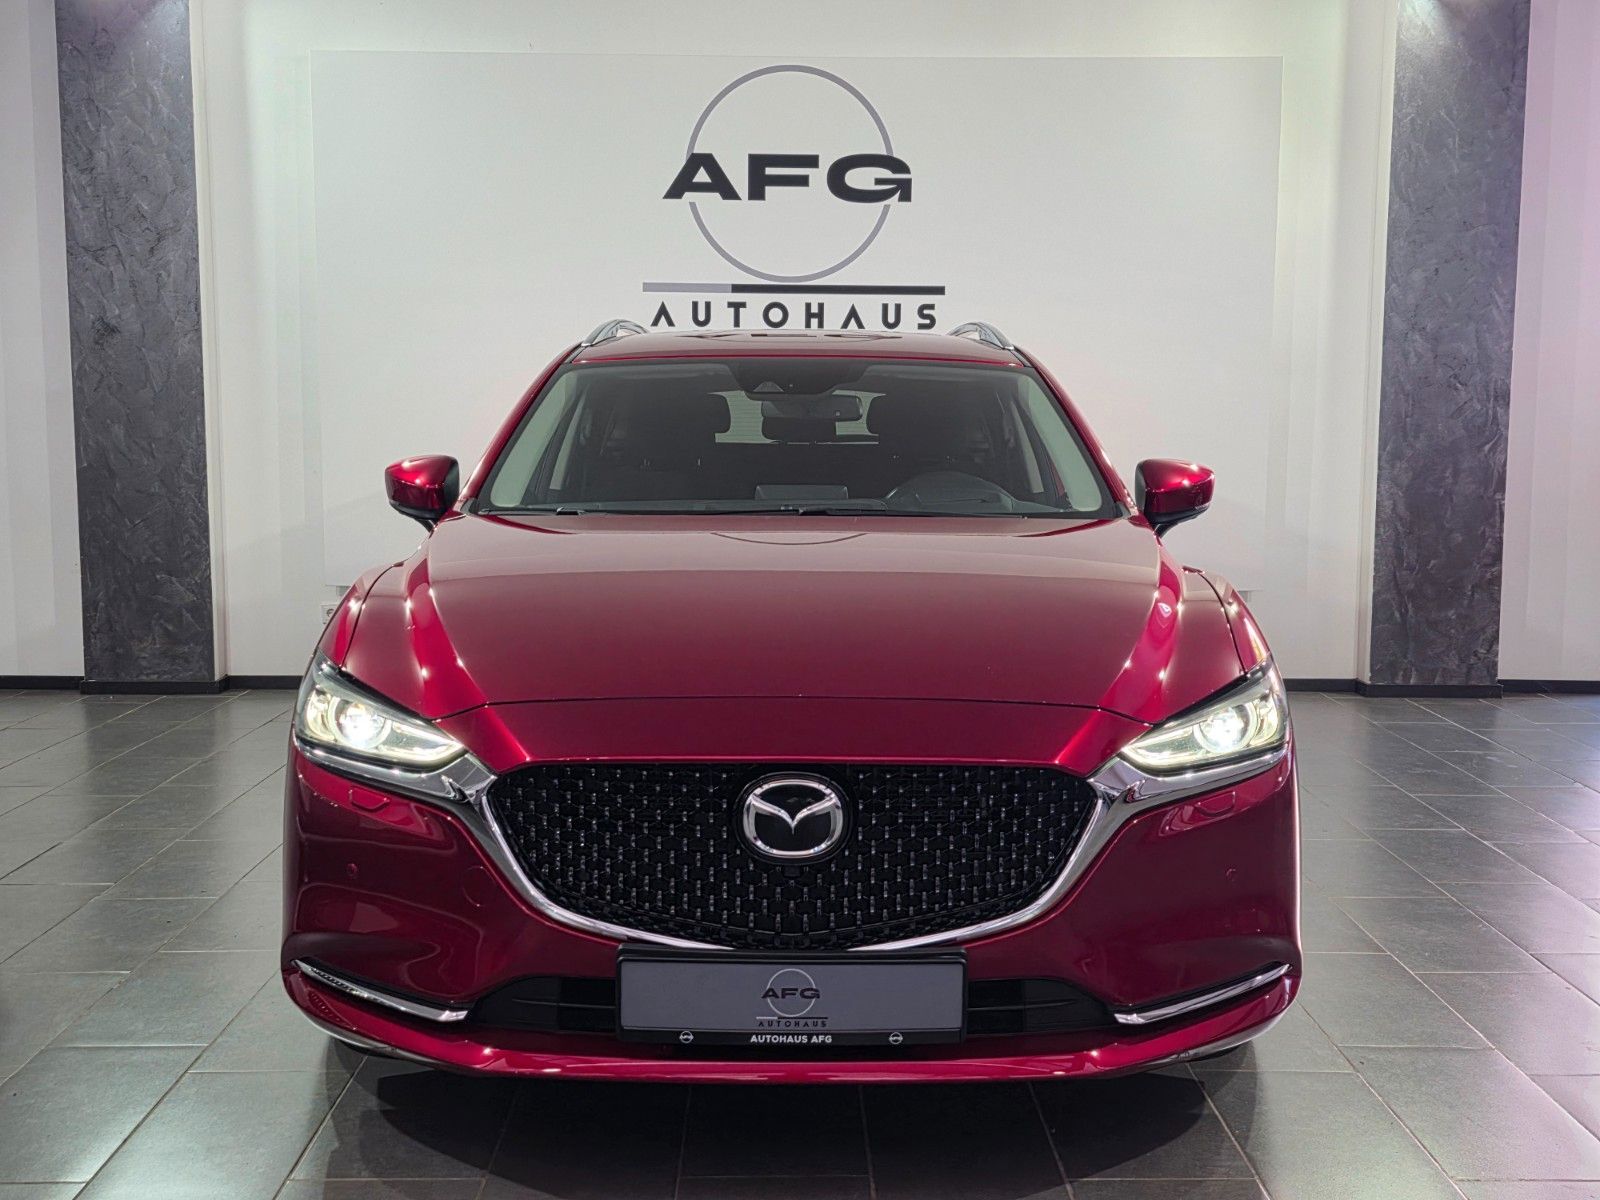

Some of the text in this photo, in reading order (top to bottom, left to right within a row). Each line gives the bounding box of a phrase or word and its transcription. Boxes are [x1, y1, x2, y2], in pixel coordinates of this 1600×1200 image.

[662, 152, 912, 203] AFG
[650, 301, 937, 330] AUTOHAUS
[761, 987, 821, 999] AFG
[758, 1020, 827, 1028] AUTOHAUS
[750, 1034, 833, 1044] AUTOHAUS AFG
